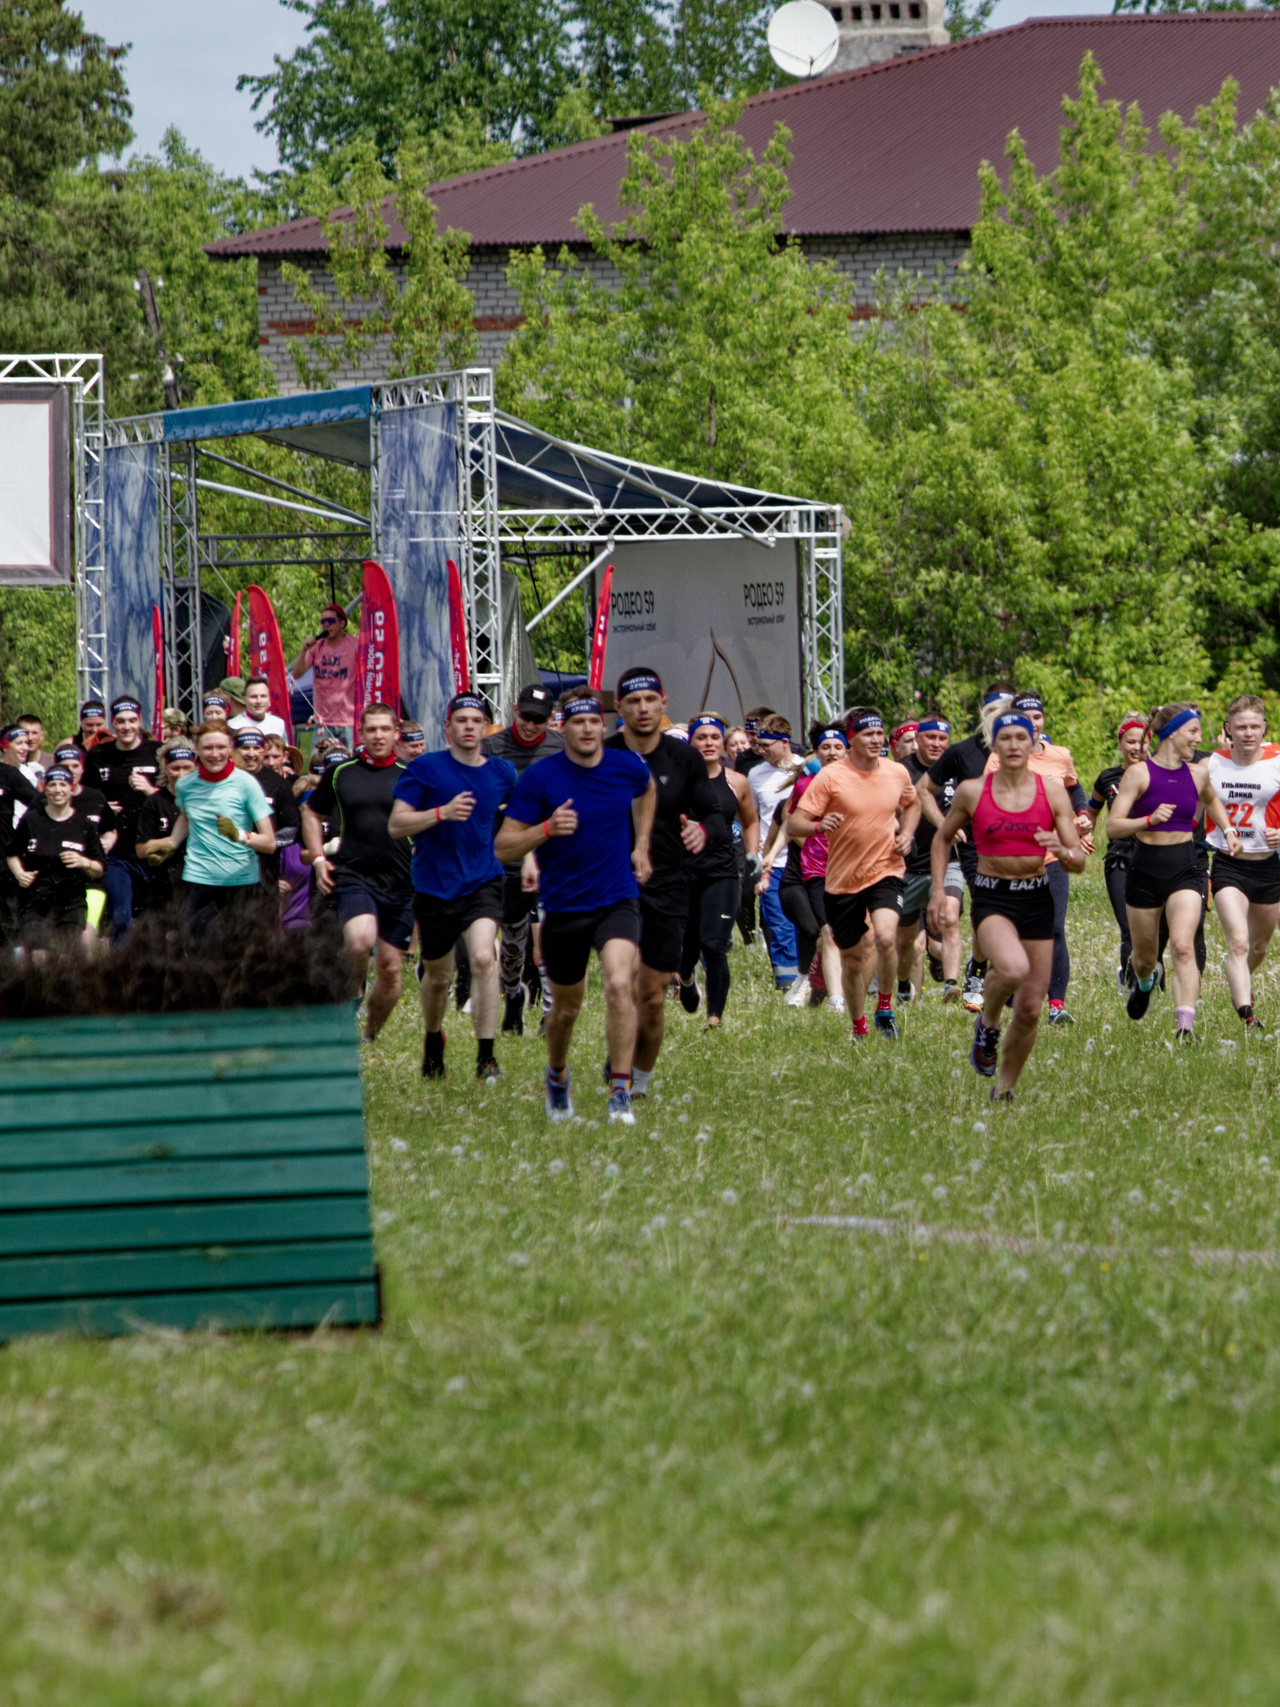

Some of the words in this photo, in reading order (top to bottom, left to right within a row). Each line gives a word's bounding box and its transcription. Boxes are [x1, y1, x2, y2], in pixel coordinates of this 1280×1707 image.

[611, 590, 643, 619] РОДЕО
[644, 589, 655, 614] 59
[743, 581, 774, 611] РОДЕО
[775, 581, 785, 606] 59
[1005, 821, 1040, 833] asics
[1225, 802, 1254, 828] 22
